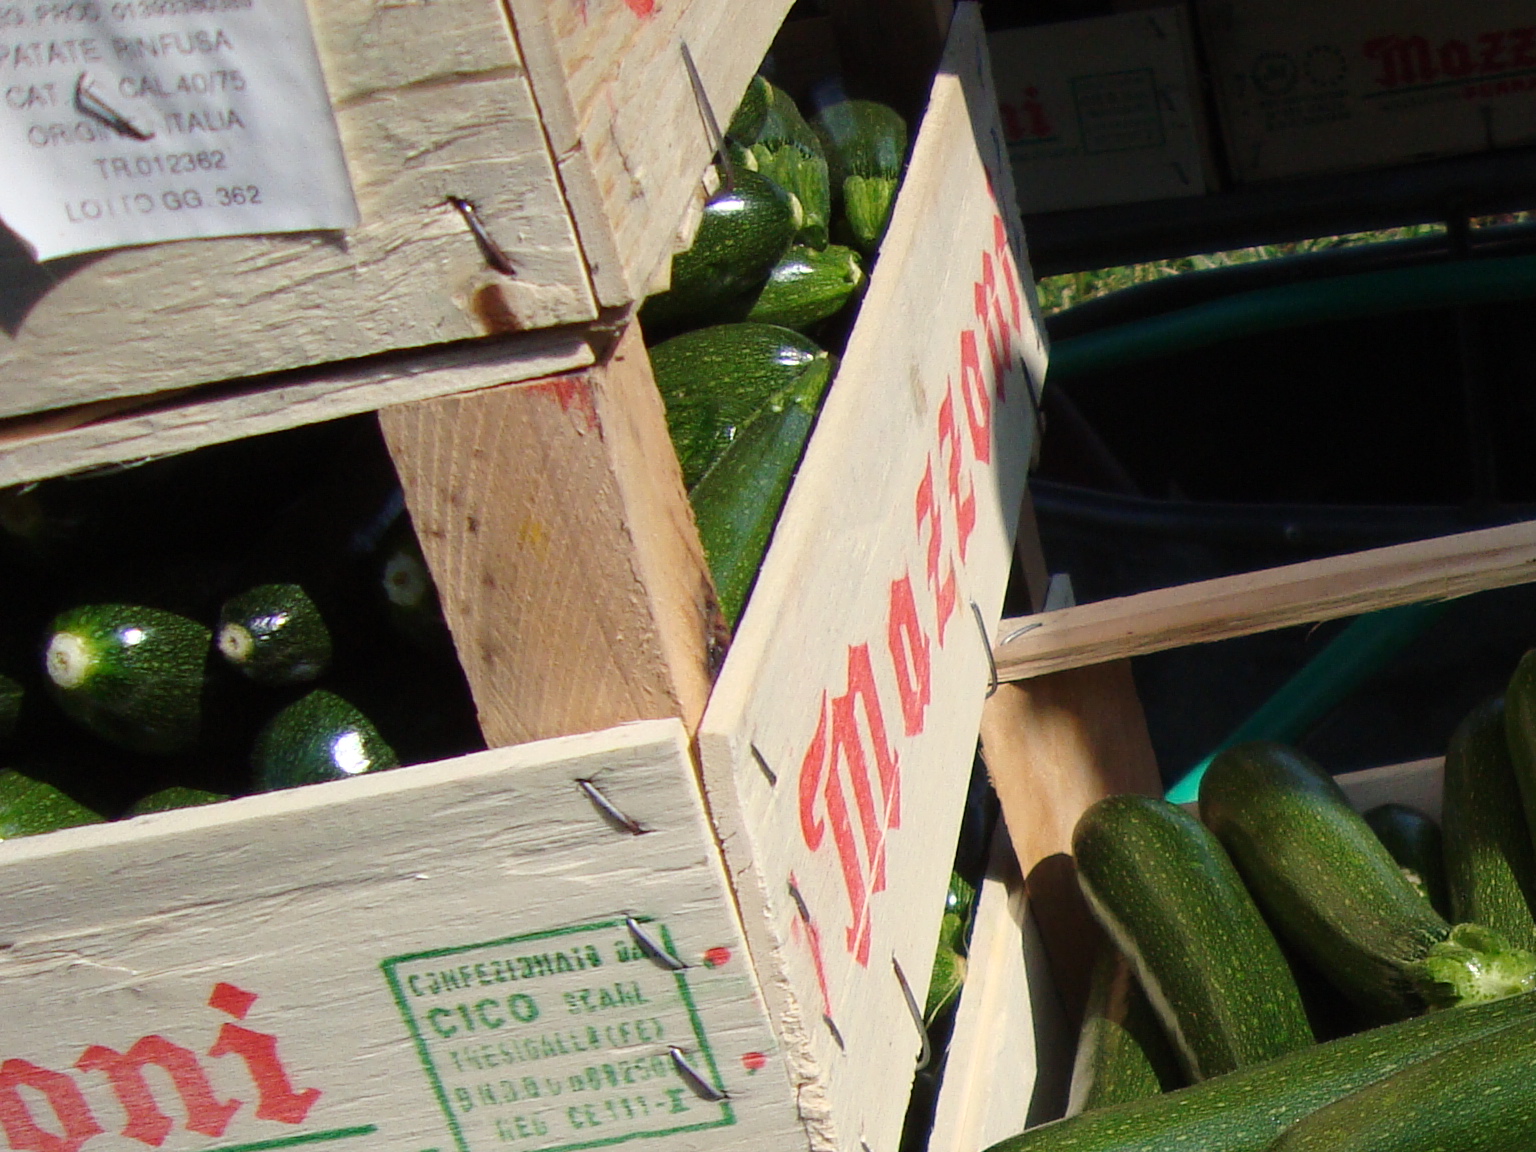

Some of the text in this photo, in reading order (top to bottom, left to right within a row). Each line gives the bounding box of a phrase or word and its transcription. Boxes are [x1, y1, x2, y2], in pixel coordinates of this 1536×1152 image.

[163, 108, 245, 134] ITALIA
[215, 185, 262, 207] 362
[426, 993, 540, 1038] CICO
